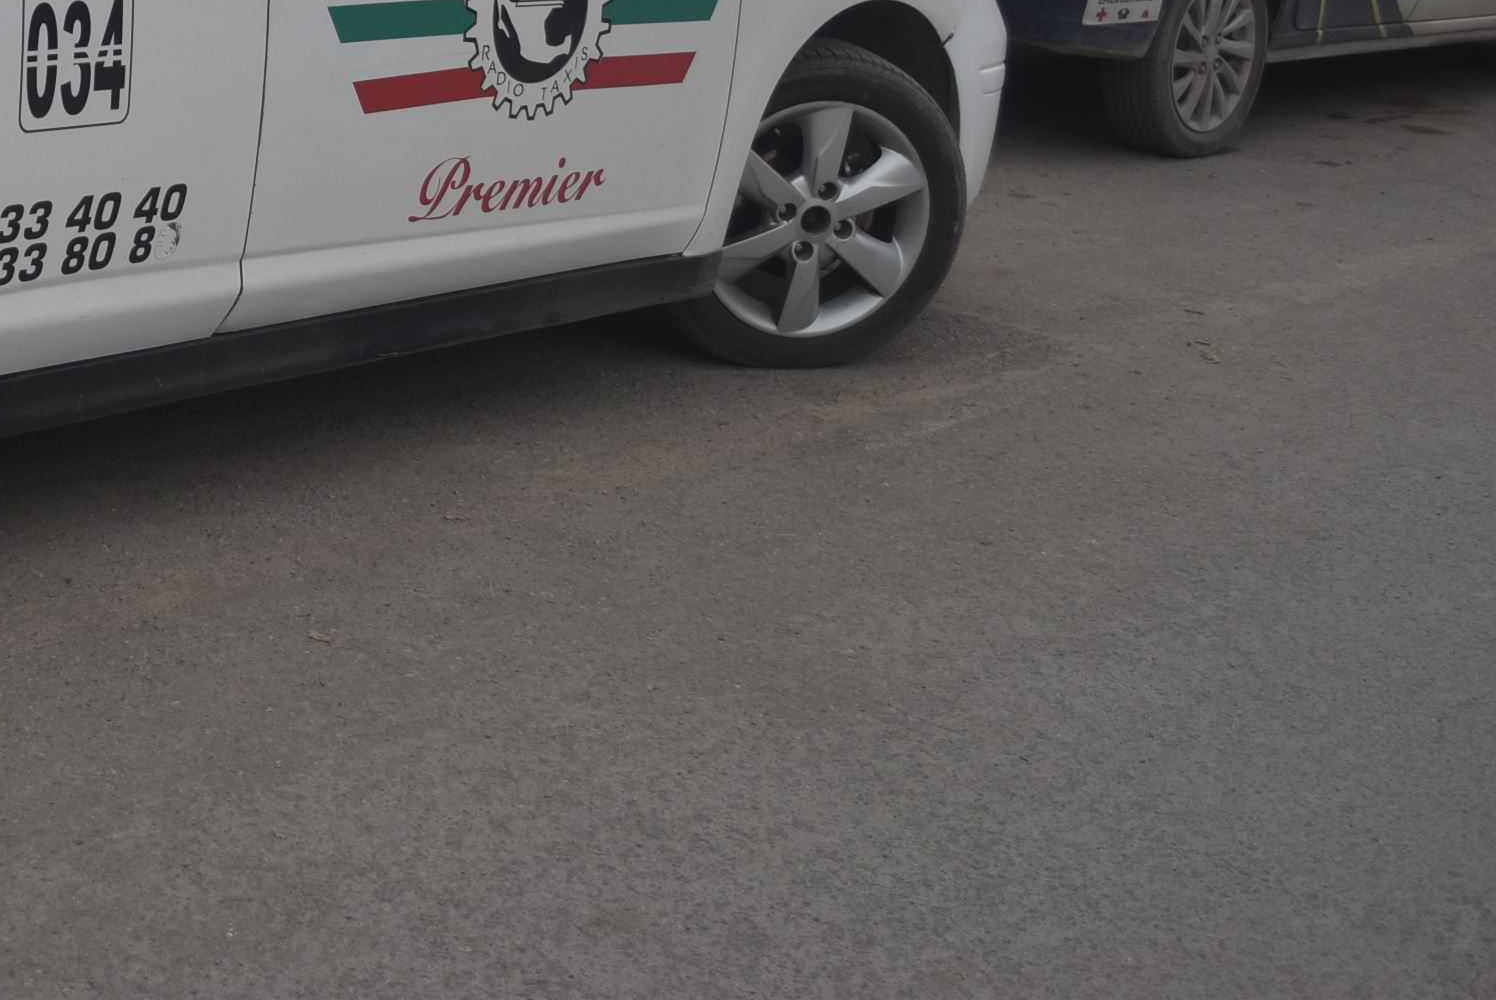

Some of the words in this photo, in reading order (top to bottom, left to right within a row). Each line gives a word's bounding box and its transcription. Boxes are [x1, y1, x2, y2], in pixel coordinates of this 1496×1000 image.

[481, 44, 524, 96] RADIO
[541, 46, 588, 101] TAXIS
[65, 192, 122, 233] 40
[133, 183, 188, 225] 40
[408, 155, 605, 222] Premier
[61, 231, 116, 275] 80
